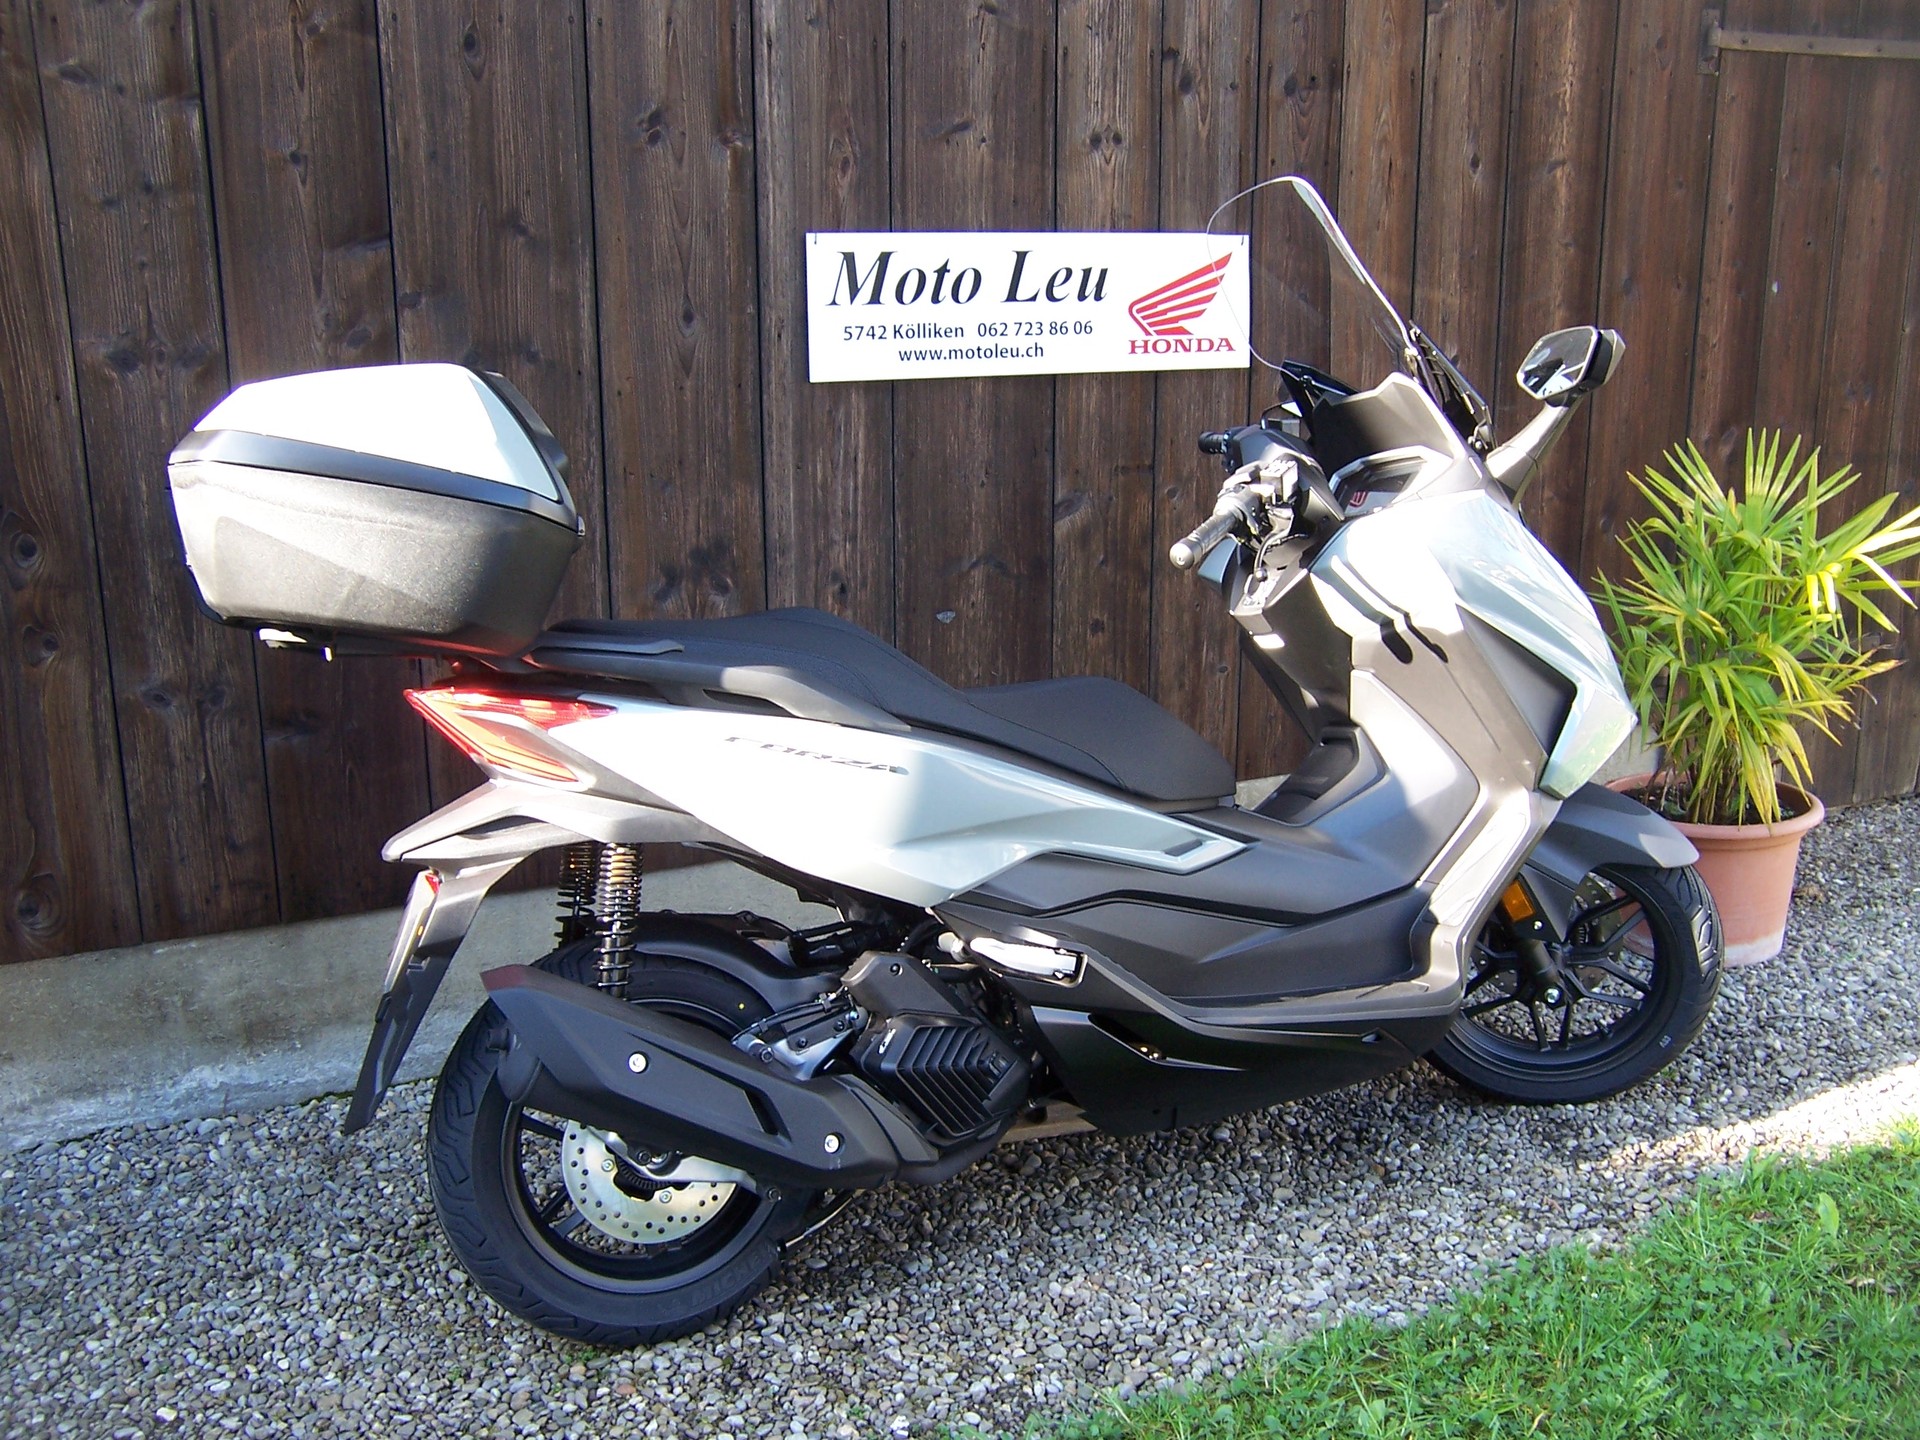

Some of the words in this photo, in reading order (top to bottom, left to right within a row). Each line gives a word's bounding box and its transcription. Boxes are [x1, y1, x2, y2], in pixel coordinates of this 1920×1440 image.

[827, 250, 982, 306] Moto
[1002, 249, 1109, 303] Leu
[843, 324, 887, 341] 5742
[893, 322, 964, 340] Kölliken
[977, 322, 1009, 338] 062
[1013, 321, 1044, 337] 723
[1048, 320, 1069, 336] 86
[1073, 320, 1093, 336] 06
[898, 342, 1044, 362] www.motoleu.ch
[1128, 337, 1236, 355] HONDA
